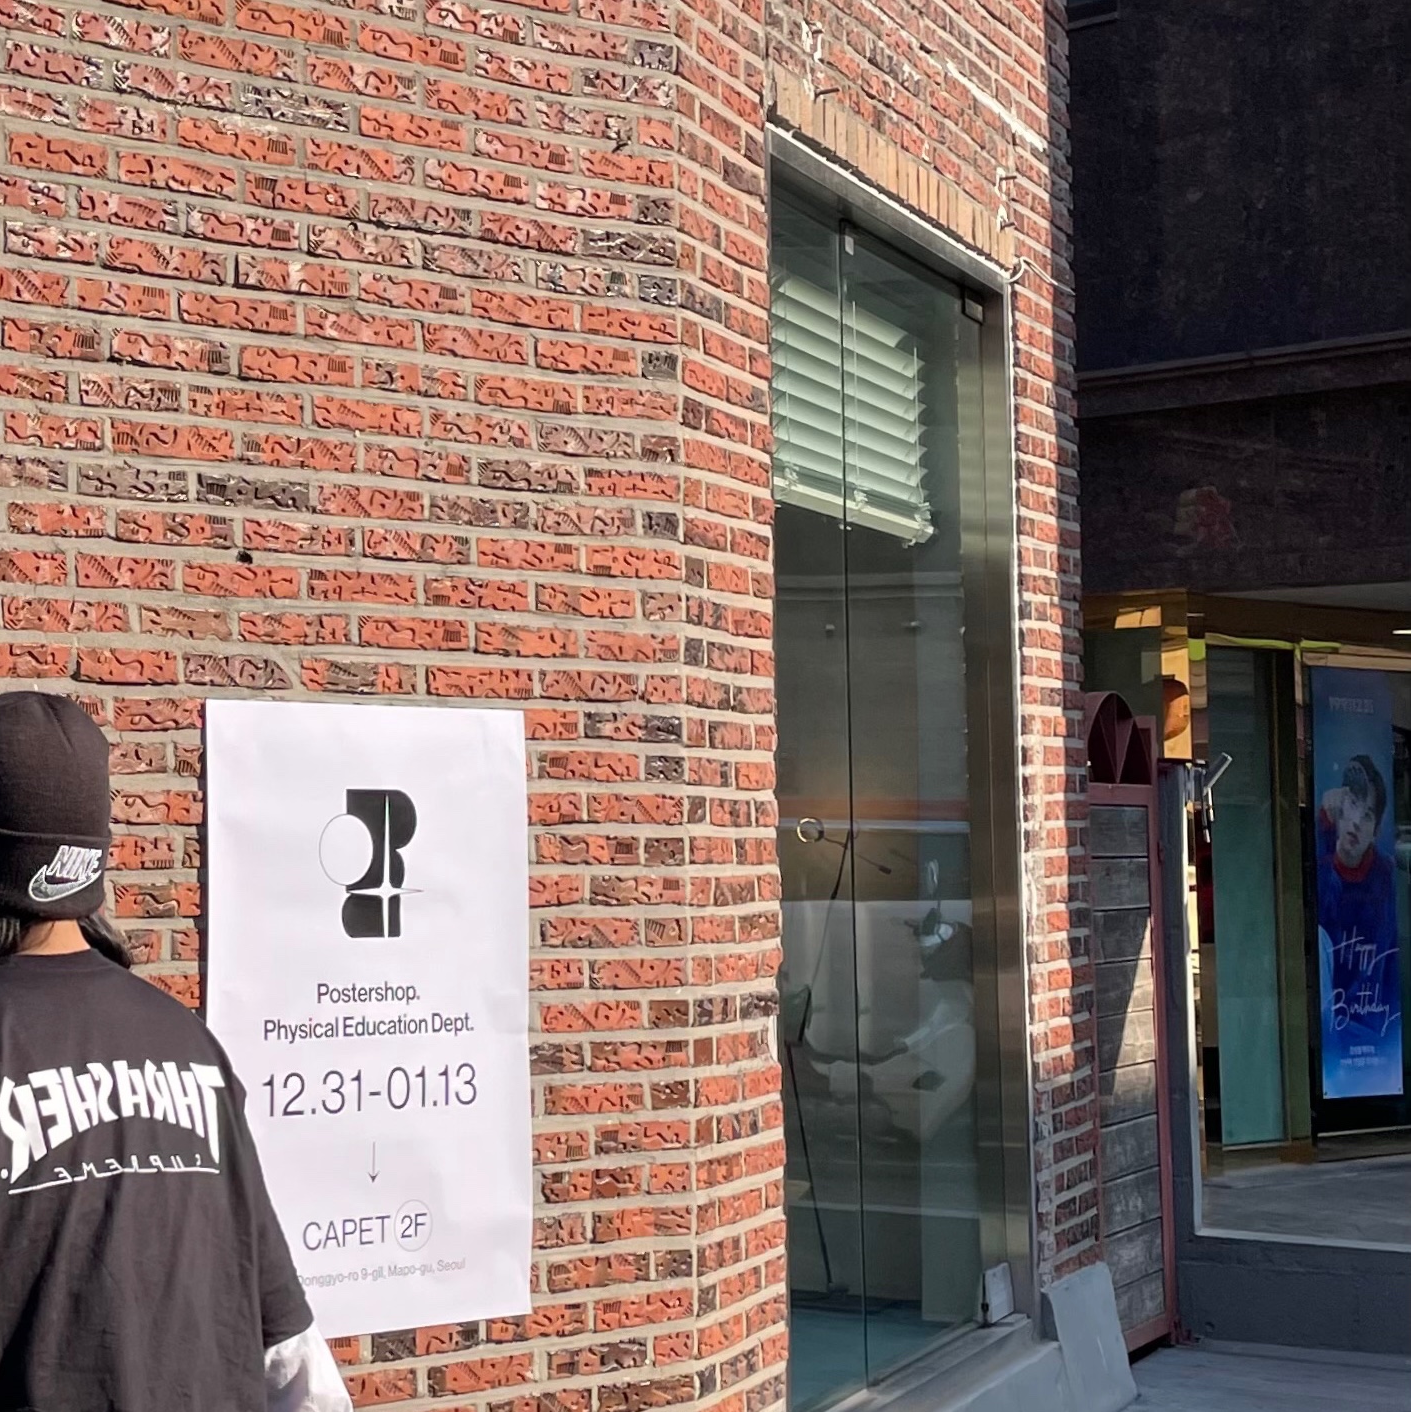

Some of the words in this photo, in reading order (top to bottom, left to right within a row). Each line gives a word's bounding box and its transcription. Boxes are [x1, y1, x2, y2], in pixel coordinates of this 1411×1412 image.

[46, 845, 103, 881] NIKE
[316, 981, 420, 1006] Postershop.
[1329, 983, 1401, 1037] Birthday
[263, 1016, 339, 1044] Physical
[342, 1015, 428, 1038] Education
[431, 1012, 474, 1036] Dept.
[262, 1062, 477, 1117] 12.31-01.13
[302, 1215, 391, 1251] CAPET
[400, 1213, 428, 1239] 2F
[437, 1257, 467, 1272] Seoul
